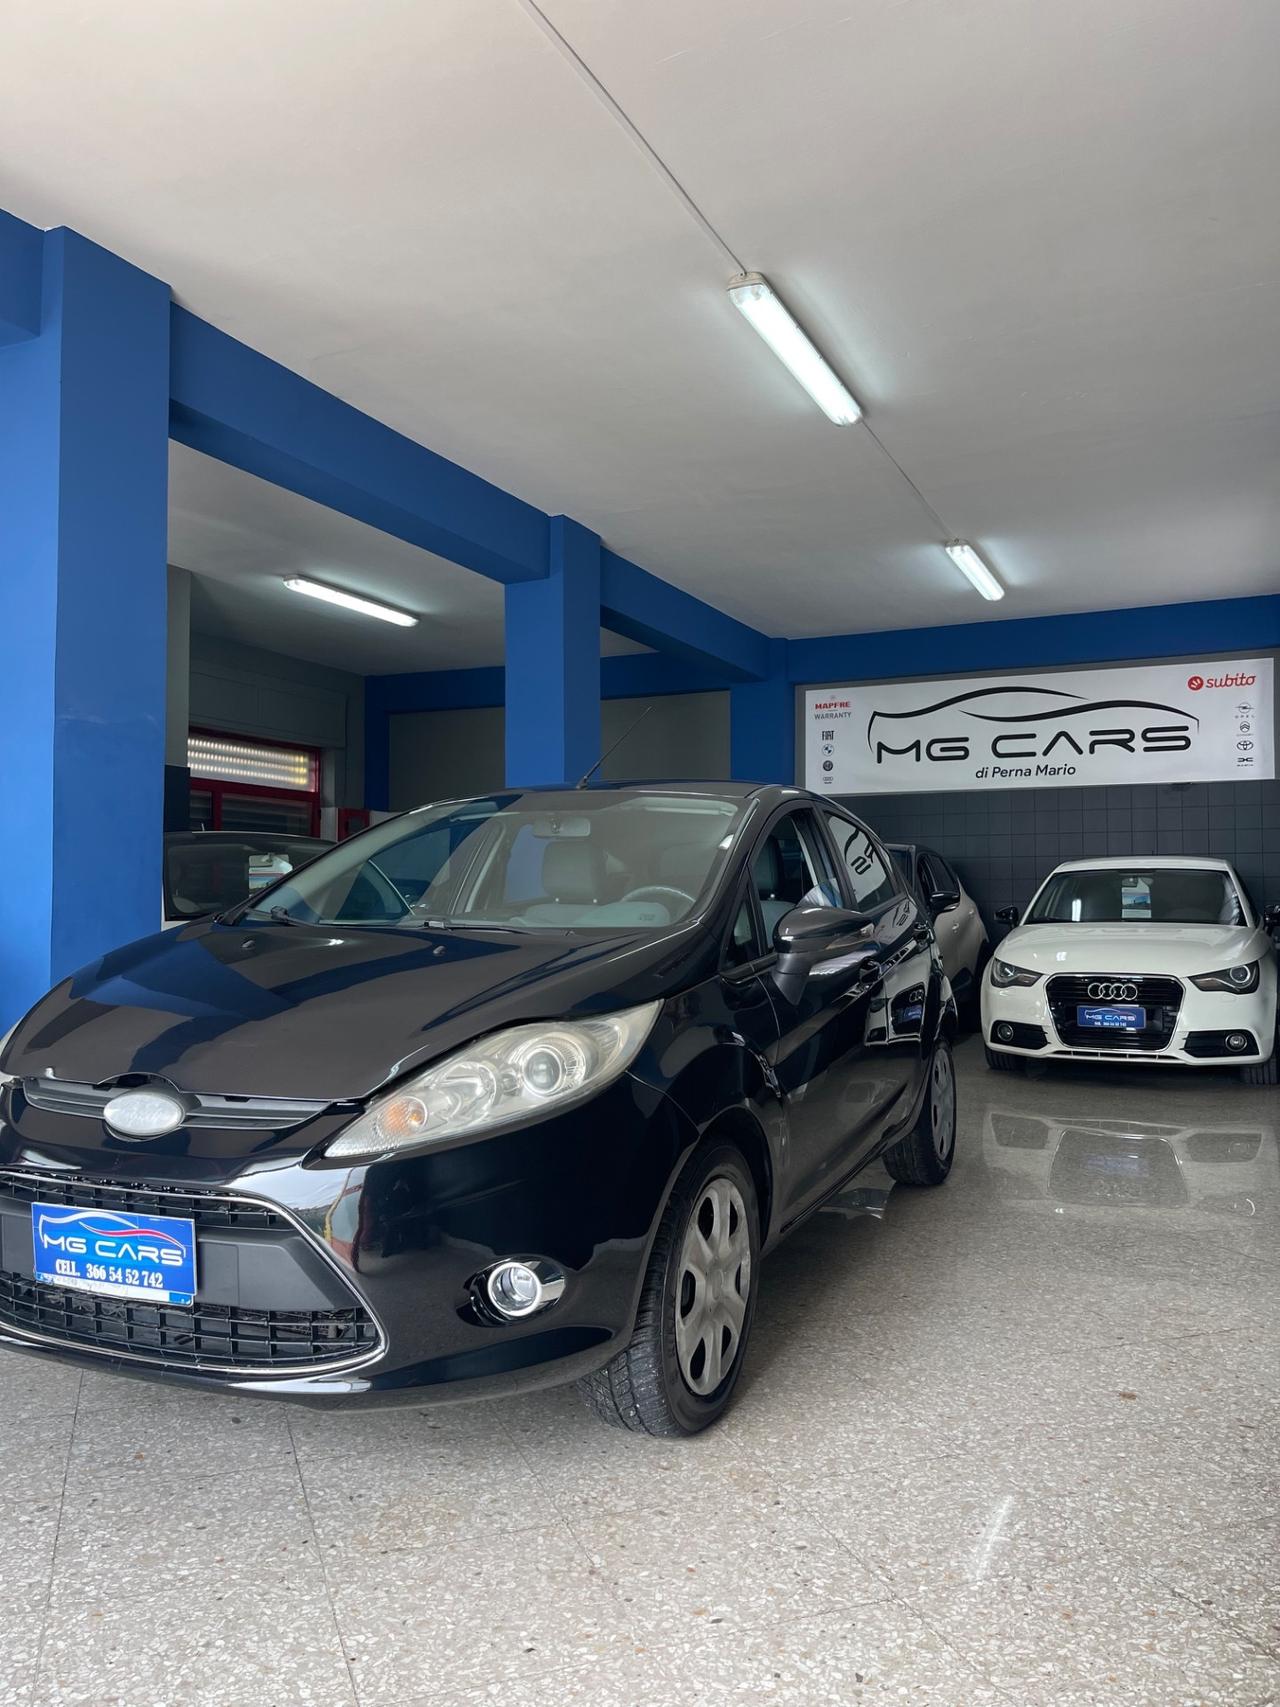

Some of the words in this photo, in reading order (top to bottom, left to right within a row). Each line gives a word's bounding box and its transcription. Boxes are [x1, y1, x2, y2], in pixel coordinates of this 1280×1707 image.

[1205, 672, 1256, 688] subito
[814, 701, 851, 710] MAPFRE
[814, 712, 852, 720] WARRANTY
[877, 736, 970, 764] MG
[991, 725, 1191, 759] CARS
[975, 766, 988, 778] di
[991, 766, 1032, 778] Perna
[1035, 763, 1076, 776] Mario
[44, 1233, 87, 1254] MG
[95, 1240, 183, 1266] CARS
[55, 1258, 80, 1276] CELL.
[86, 1262, 107, 1280] 366
[109, 1266, 123, 1282] 54
[125, 1268, 139, 1285] 52
[141, 1270, 164, 1288] 742
